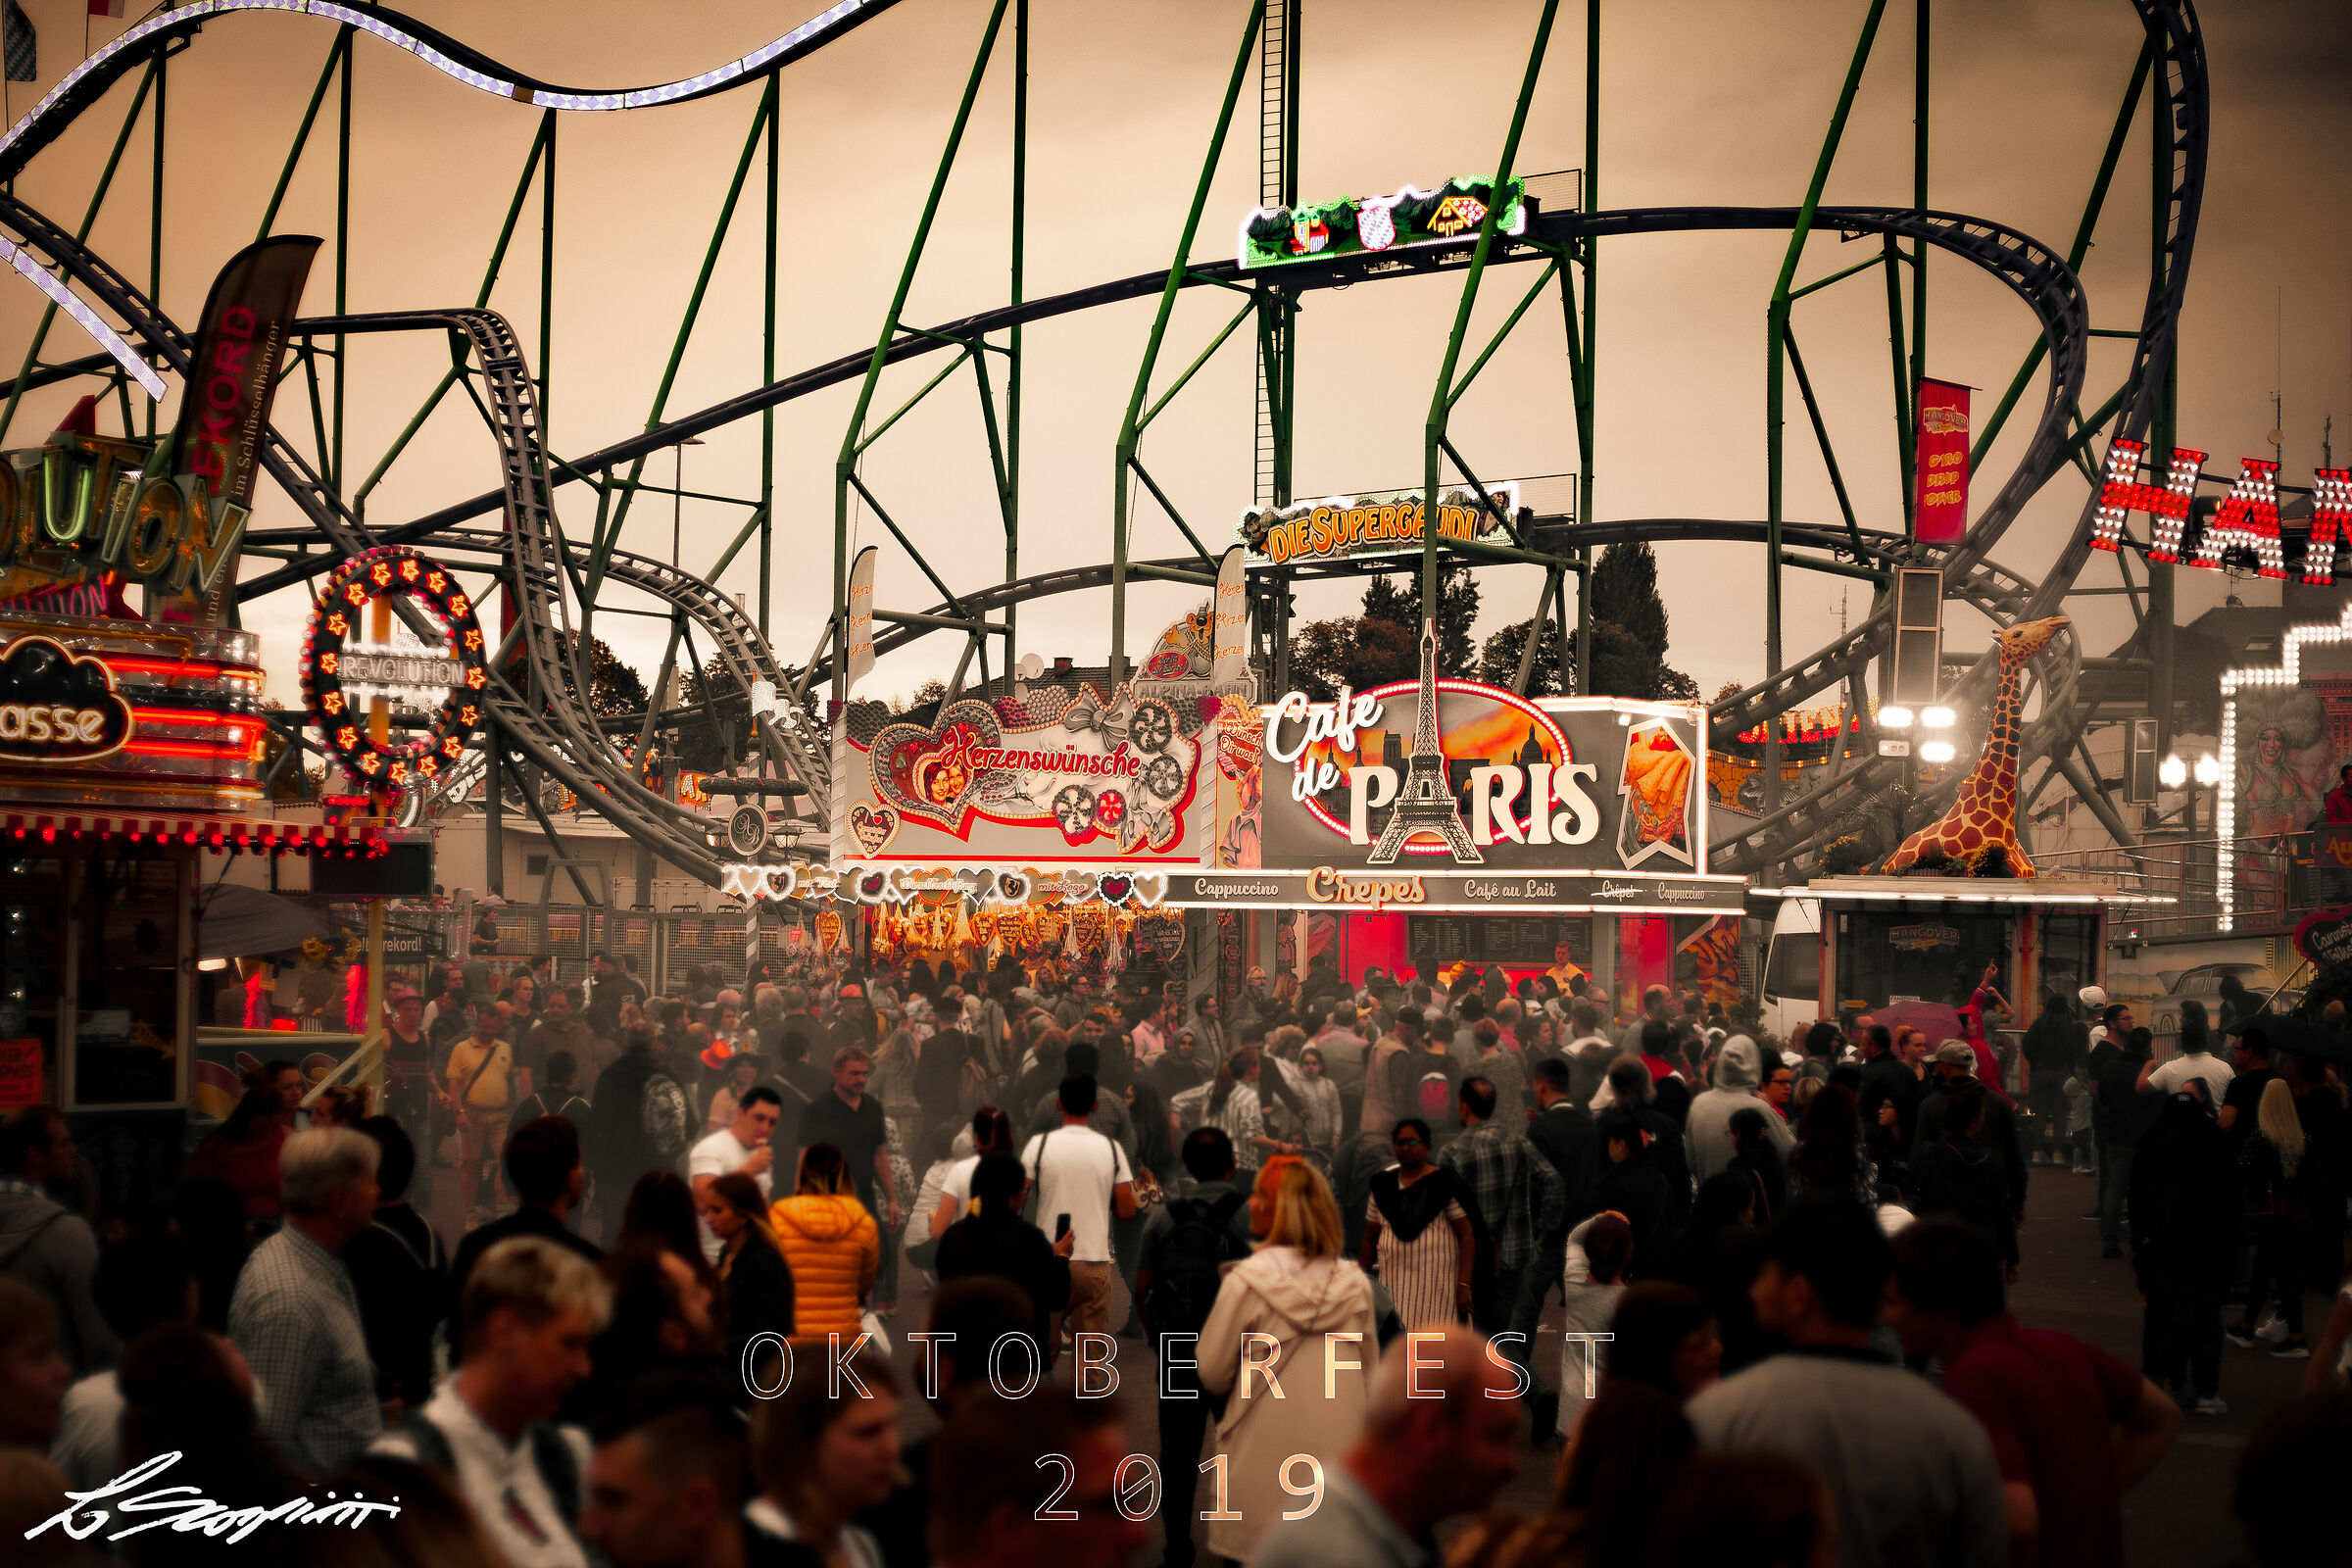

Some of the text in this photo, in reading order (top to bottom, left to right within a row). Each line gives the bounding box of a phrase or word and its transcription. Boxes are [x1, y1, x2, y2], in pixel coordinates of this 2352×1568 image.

[190, 306, 256, 494] EKORD
[236, 319, 280, 472] Schlüsselhänger
[1269, 518, 1312, 564] DIE
[940, 725, 1143, 778] Herzenswünsche
[1291, 757, 1341, 803] de
[1348, 762, 1601, 851] PARIS
[1056, 880, 1087, 895] Logo
[1194, 877, 1279, 900] Cappuccino
[1306, 865, 1426, 912] Crepes
[1501, 885, 1522, 899] au
[1524, 879, 1557, 900] Lait
[1657, 881, 1706, 905] Cappuccino
